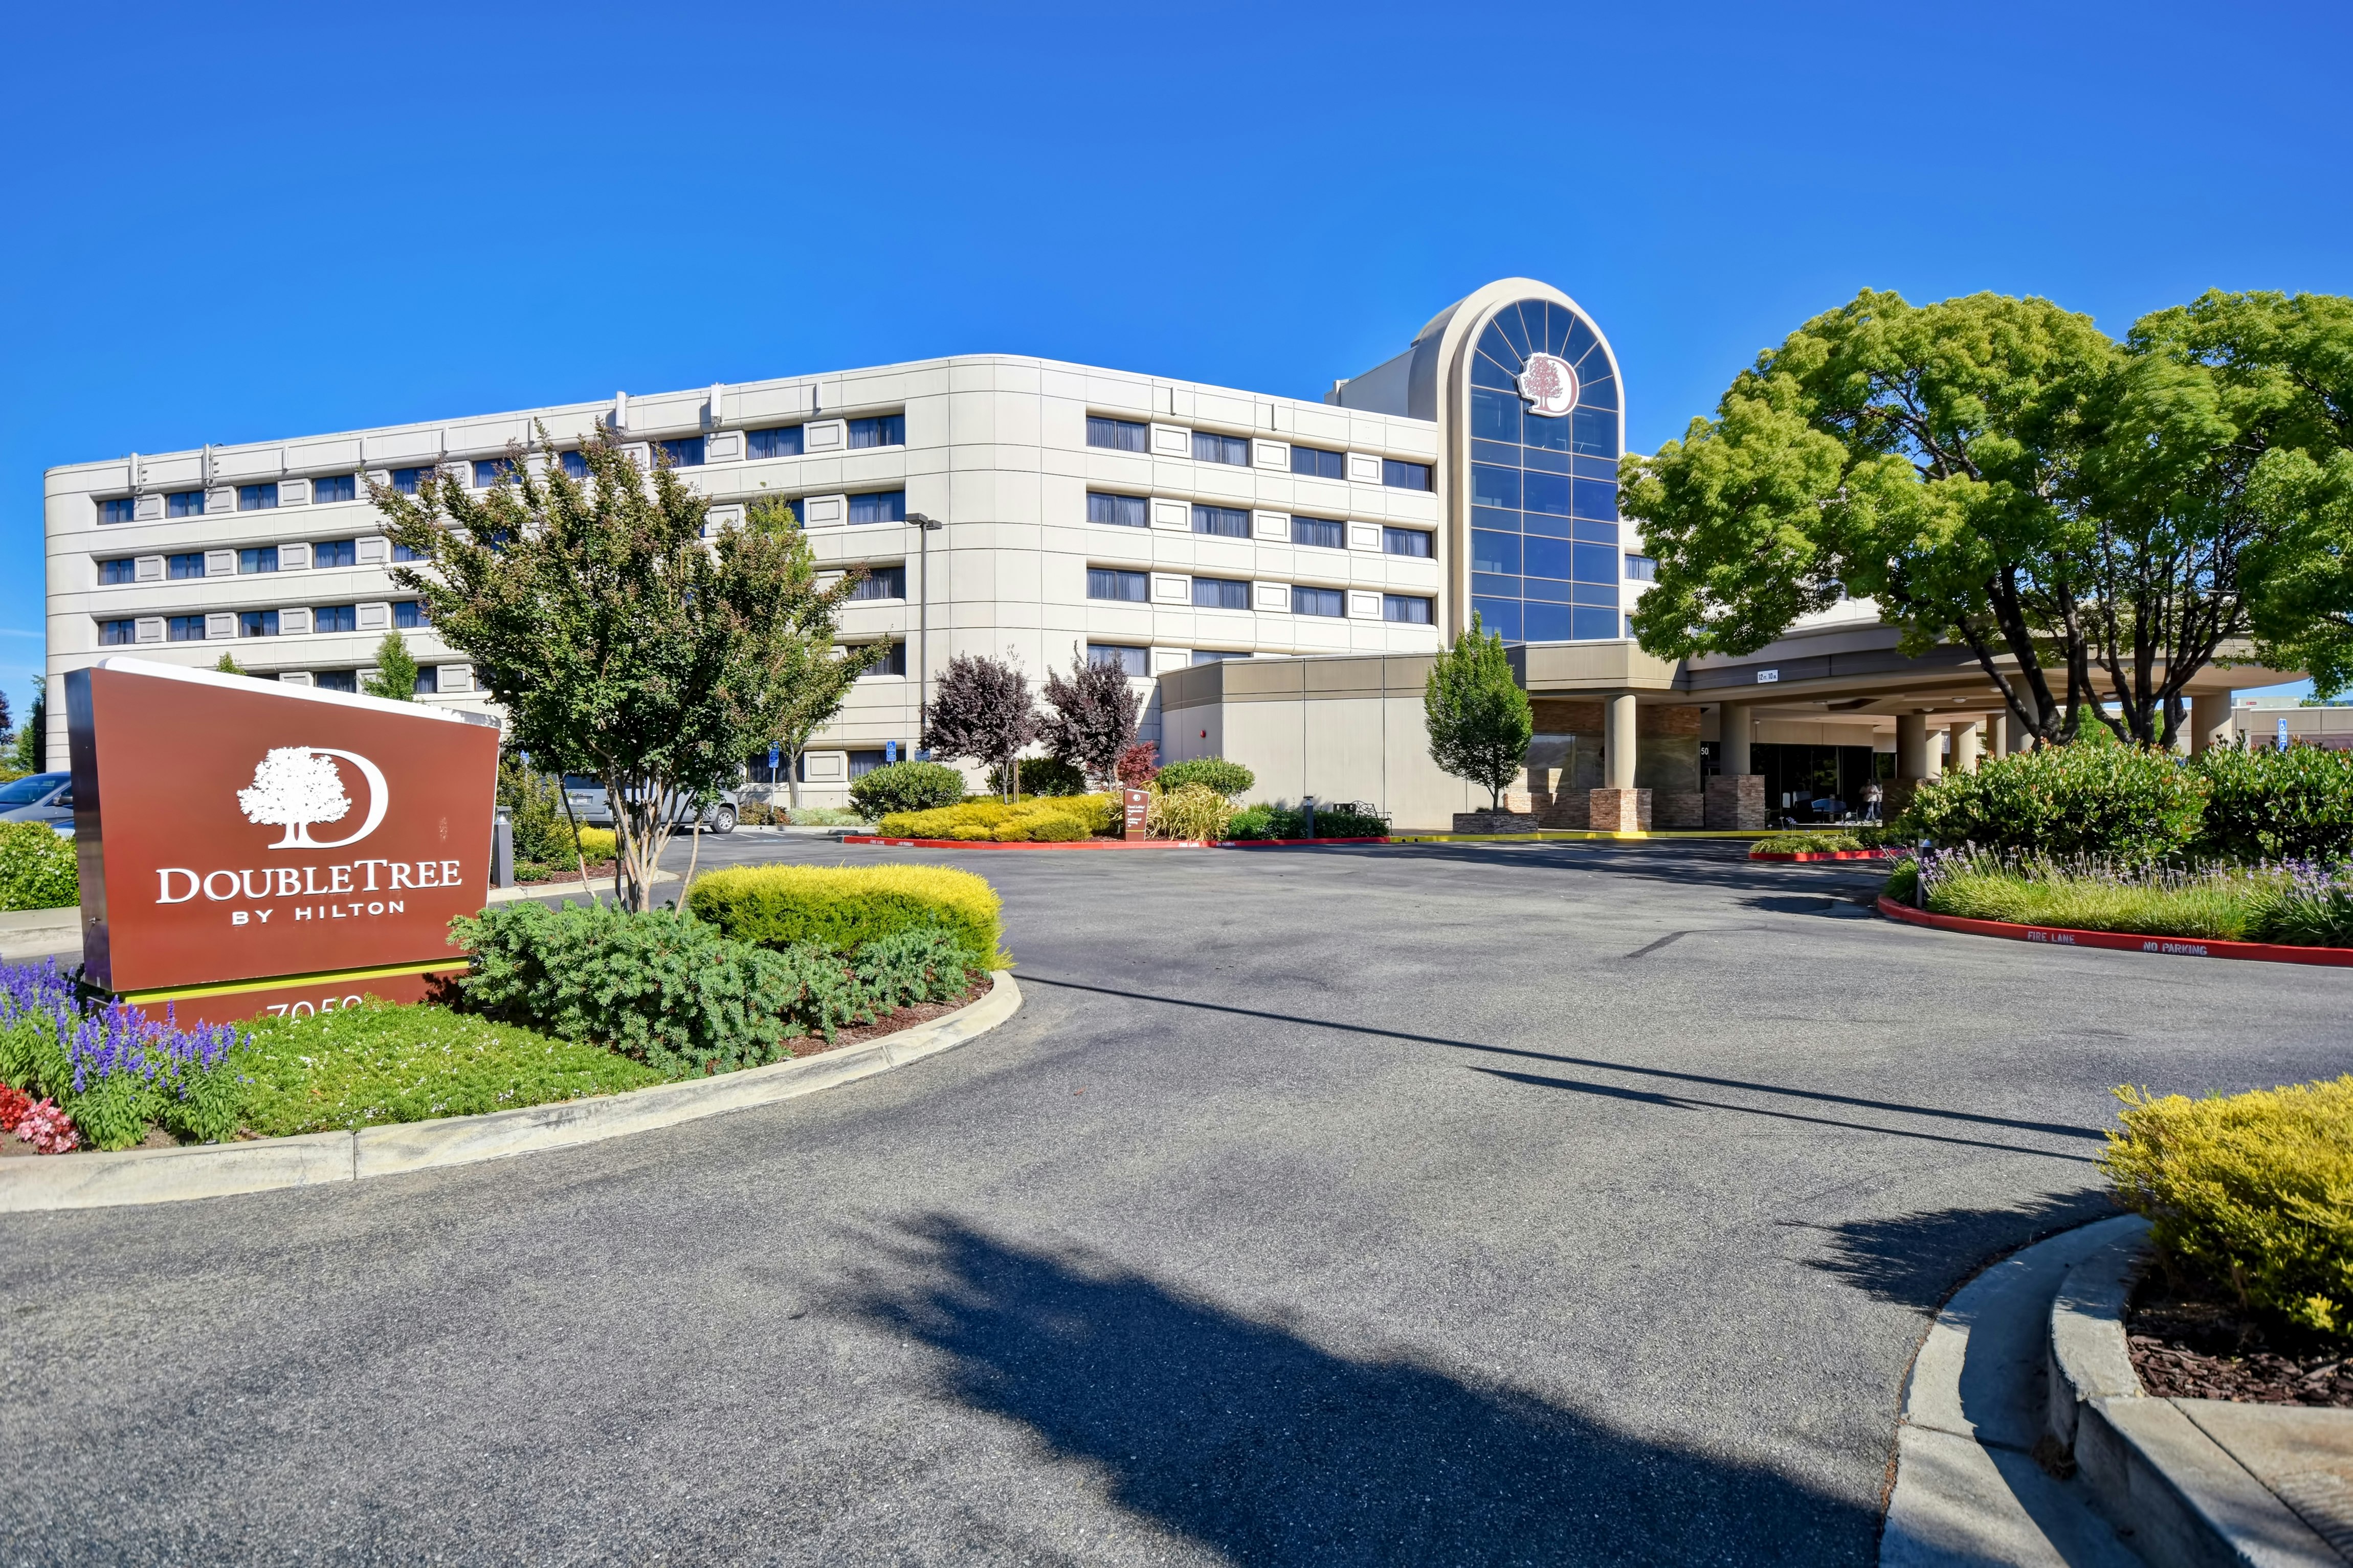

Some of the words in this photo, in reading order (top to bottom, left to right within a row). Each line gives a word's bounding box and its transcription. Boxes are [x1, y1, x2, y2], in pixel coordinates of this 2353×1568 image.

[232, 909, 274, 926] BY
[295, 901, 405, 921] HILTON
[2028, 931, 2047, 941] FIRE
[2051, 933, 2075, 944] LANE
[2143, 942, 2158, 952] NO
[2162, 943, 2208, 956] PARKING
